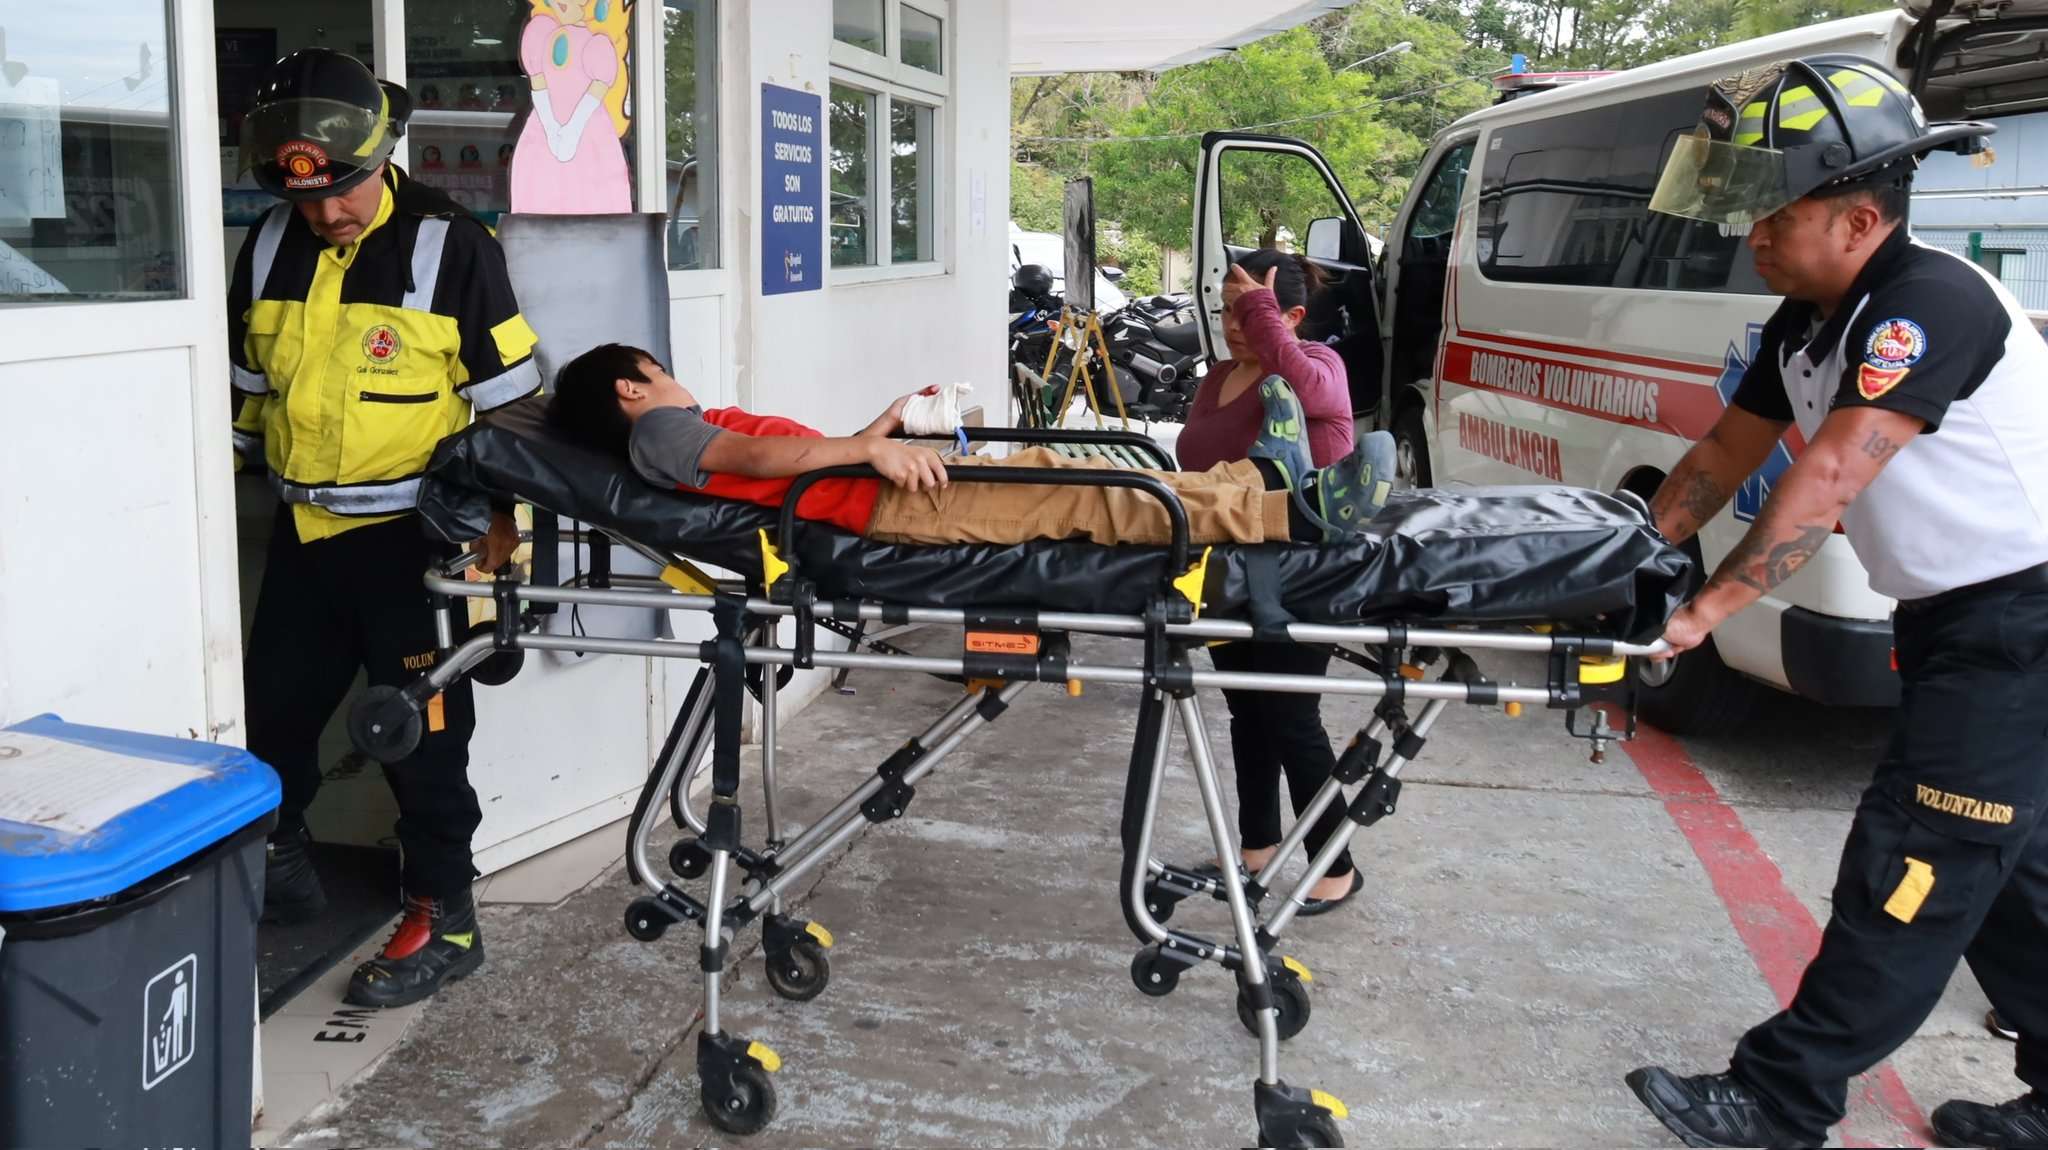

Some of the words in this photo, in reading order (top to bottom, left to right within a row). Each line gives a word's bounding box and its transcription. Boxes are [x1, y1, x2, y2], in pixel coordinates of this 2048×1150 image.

[771, 110, 797, 131] TODOS
[798, 115, 813, 133] LOS
[774, 142, 812, 163] SERVICIOS
[785, 174, 801, 192] SON
[772, 205, 814, 223] GRATUITOS
[1470, 351, 1542, 398] BOMBEROS
[1543, 364, 1660, 423] VOLUNTARIOS
[1458, 411, 1565, 482] AMBULANCIA
[403, 650, 436, 670] VOLUN
[1916, 783, 2014, 825] VOLUNTARIOS
